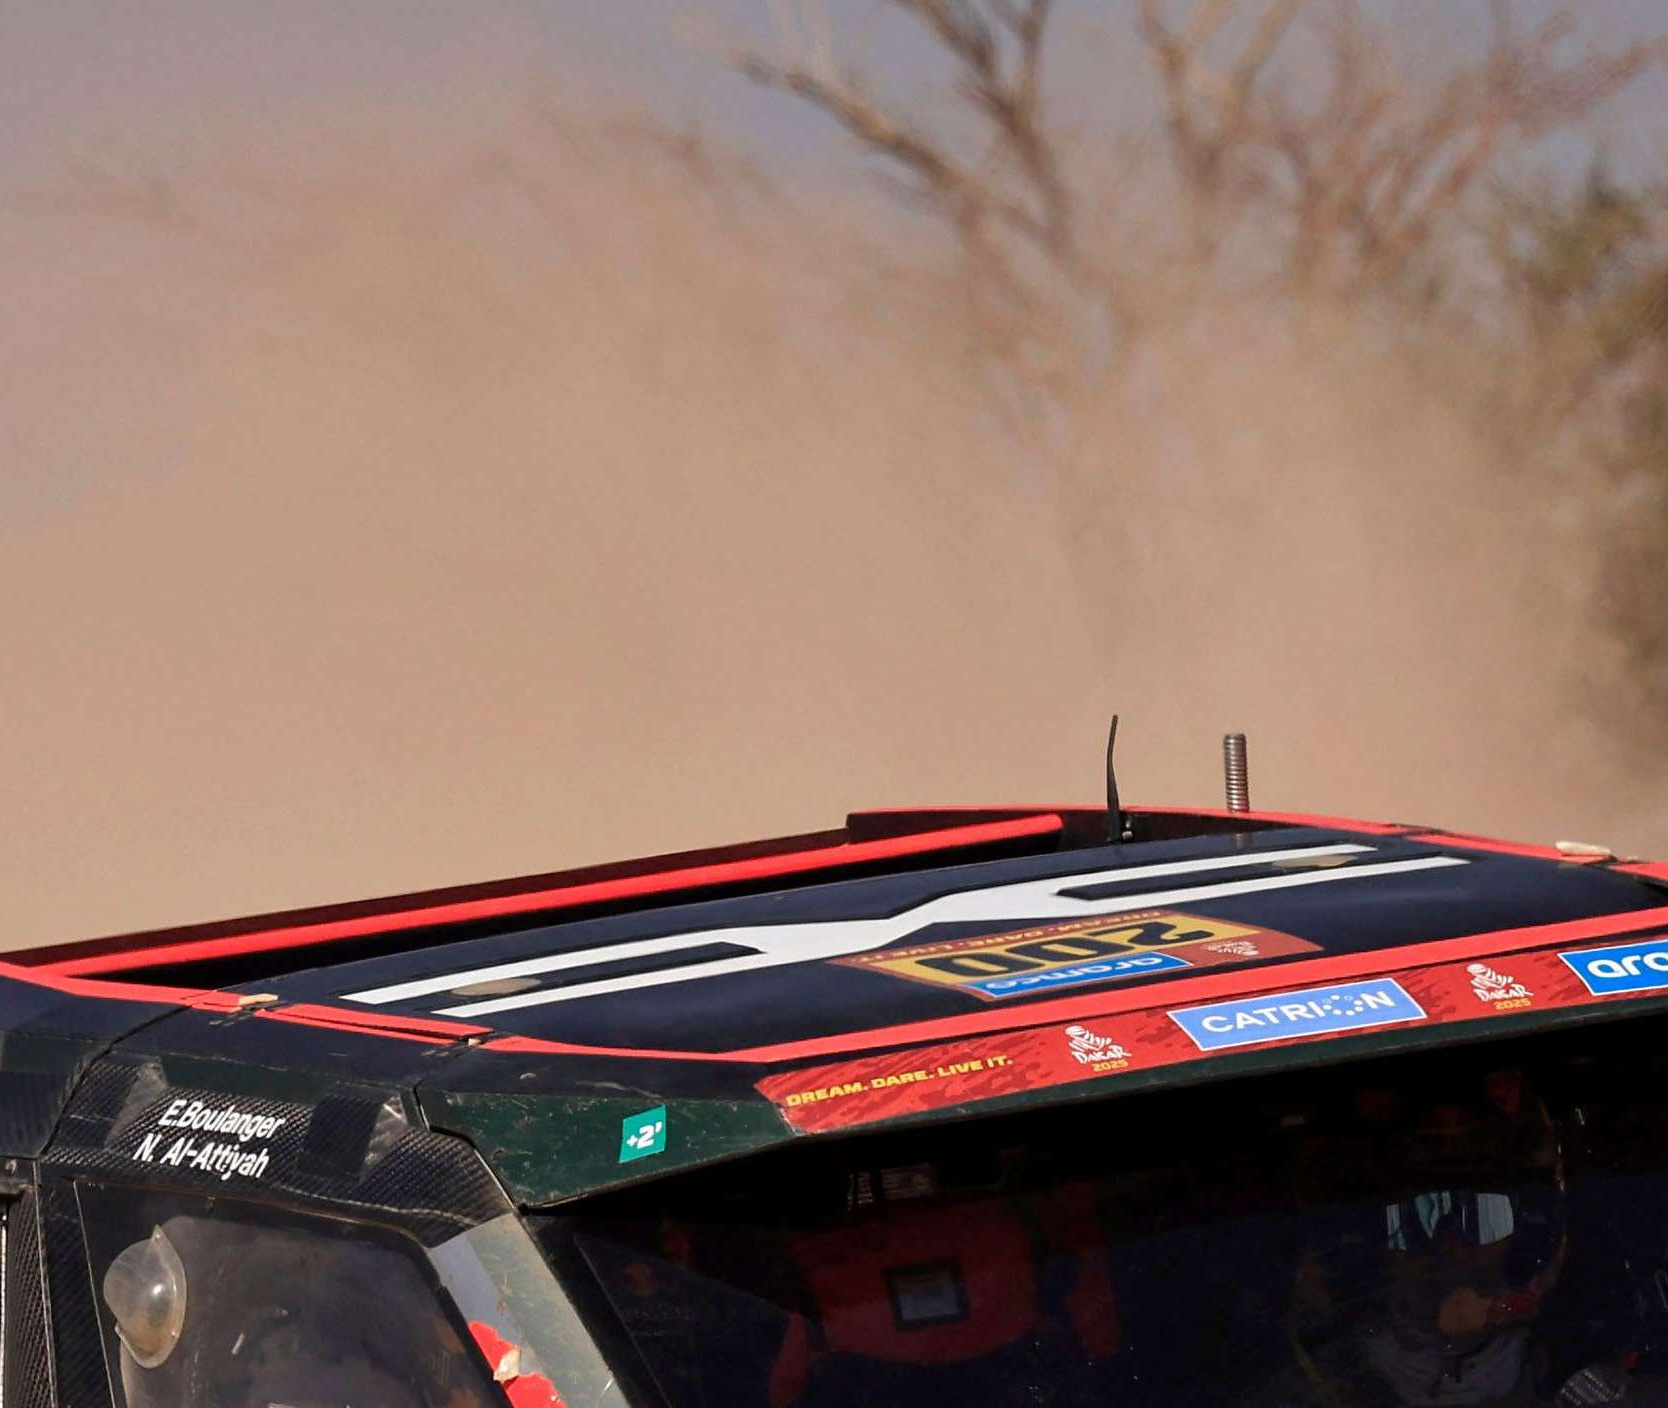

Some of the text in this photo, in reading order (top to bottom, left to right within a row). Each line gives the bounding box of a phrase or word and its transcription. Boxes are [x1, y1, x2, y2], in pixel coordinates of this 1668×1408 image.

[915, 921, 1215, 977] 200
[985, 957, 1163, 990] aramco
[1494, 998, 1531, 1010] 2025
[786, 1055, 1013, 1106] DREAM. DARE. LIVE IT.
[1092, 1059, 1129, 1072] 2025
[158, 1100, 285, 1142] E.Boulanger
[133, 1133, 270, 1180] N. Al-Attiyah
